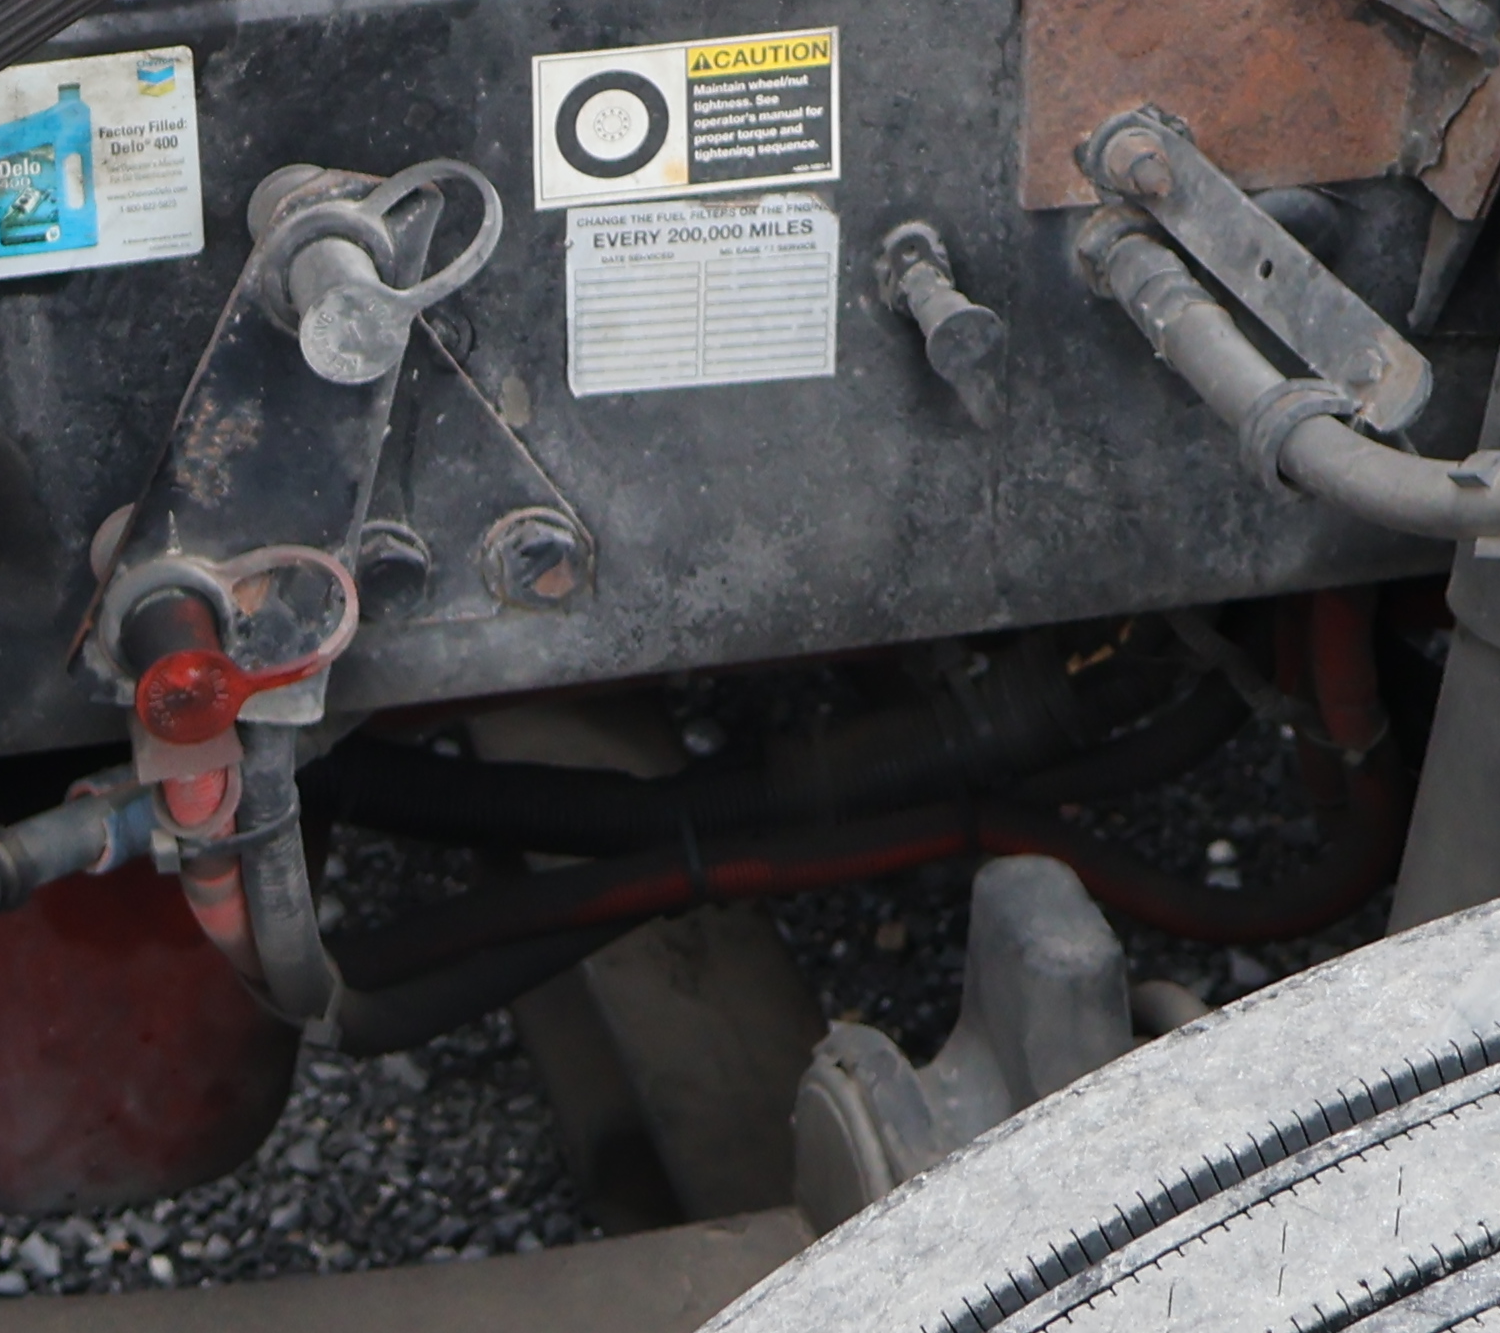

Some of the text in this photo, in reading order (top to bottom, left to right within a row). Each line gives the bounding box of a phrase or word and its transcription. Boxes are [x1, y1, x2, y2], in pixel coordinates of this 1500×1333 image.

[713, 40, 829, 69] CAUTION
[693, 74, 808, 96] Maintain wheel/nut
[693, 93, 778, 113] tightness. See
[694, 105, 822, 129] operator's manual for
[98, 122, 145, 141] Factory
[154, 134, 178, 150] 400
[694, 123, 802, 145] proper torque and
[694, 139, 818, 162] tightening sequence.
[576, 213, 626, 229] CHANGE
[630, 212, 652, 223] THE
[656, 209, 685, 222] FUEL
[739, 204, 756, 216] ON
[762, 203, 782, 215] THE
[593, 216, 812, 250] EVERY 200,000 MILES
